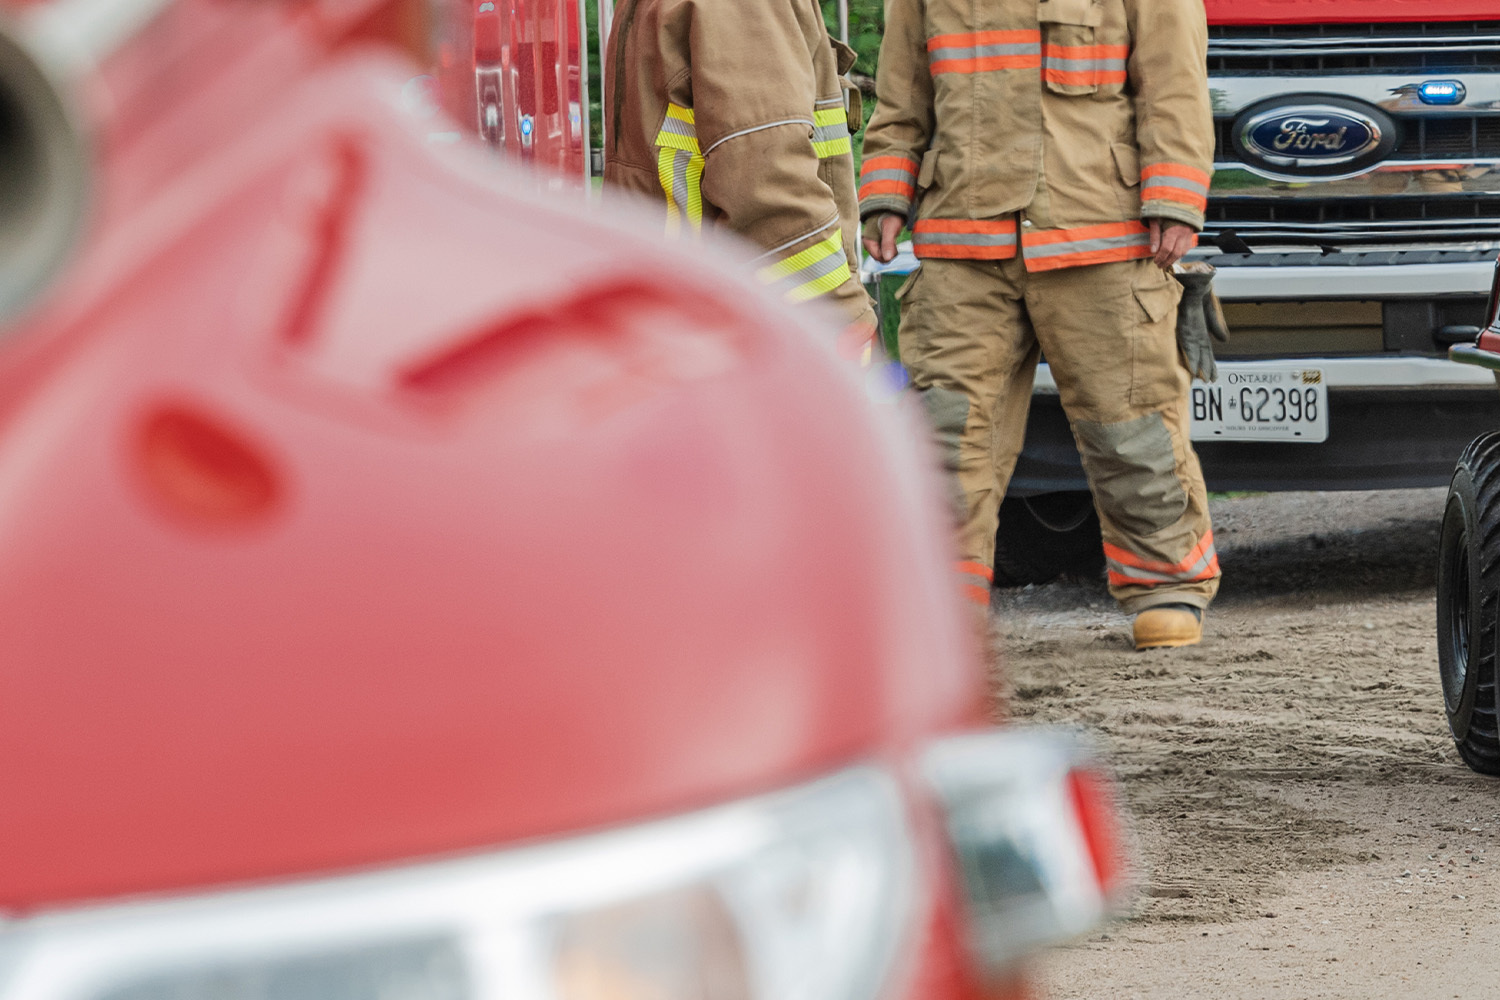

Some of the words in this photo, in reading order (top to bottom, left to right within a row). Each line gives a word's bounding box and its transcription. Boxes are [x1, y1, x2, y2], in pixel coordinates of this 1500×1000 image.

[1273, 116, 1349, 150] Ford
[1228, 372, 1282, 384] ONTARIO
[1192, 387, 1223, 421] BN
[1240, 387, 1318, 422] 62398
